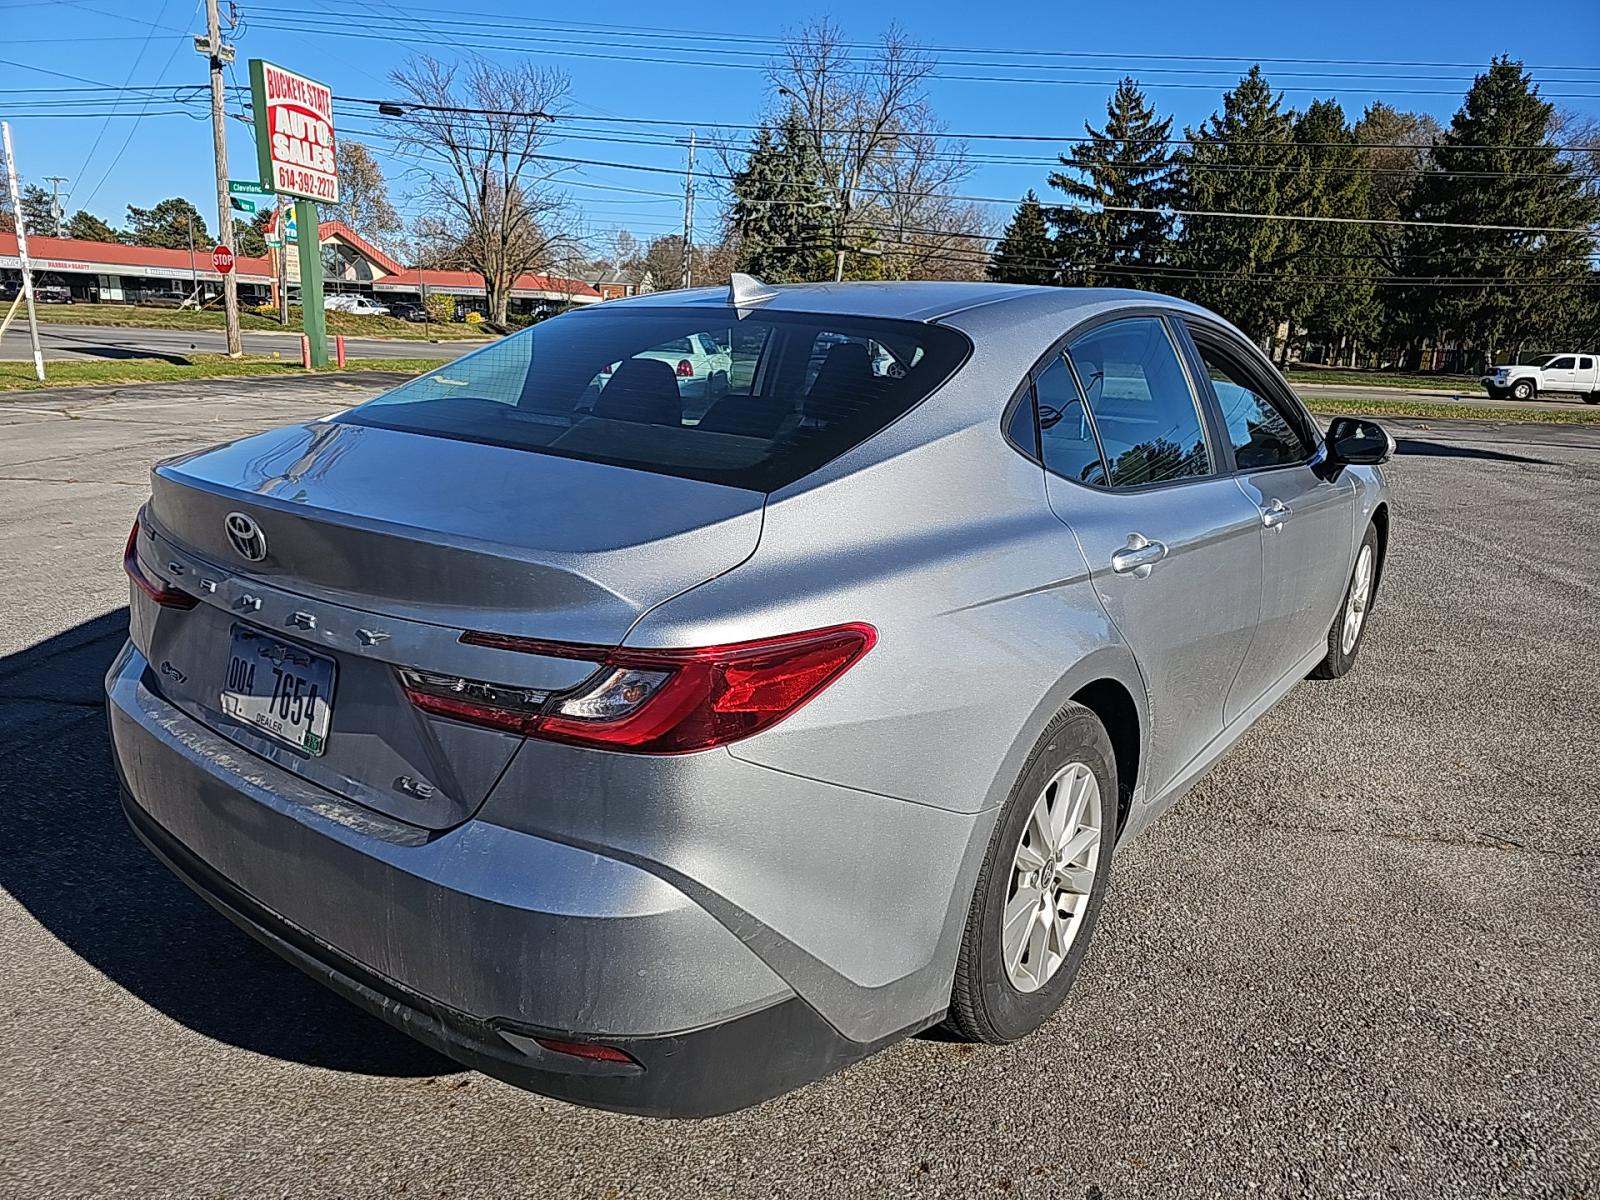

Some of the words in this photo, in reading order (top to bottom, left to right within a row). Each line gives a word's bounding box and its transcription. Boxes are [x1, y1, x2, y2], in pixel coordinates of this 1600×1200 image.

[266, 67, 307, 103] BUCKEYE
[307, 83, 330, 119] STATE
[275, 105, 331, 148] AUTO
[272, 132, 335, 174] SALES
[213, 254, 232, 266] STOP
[168, 561, 391, 646] CAMRY
[228, 656, 256, 696] 004
[268, 667, 318, 732] 7654
[255, 712, 283, 733] DEALER
